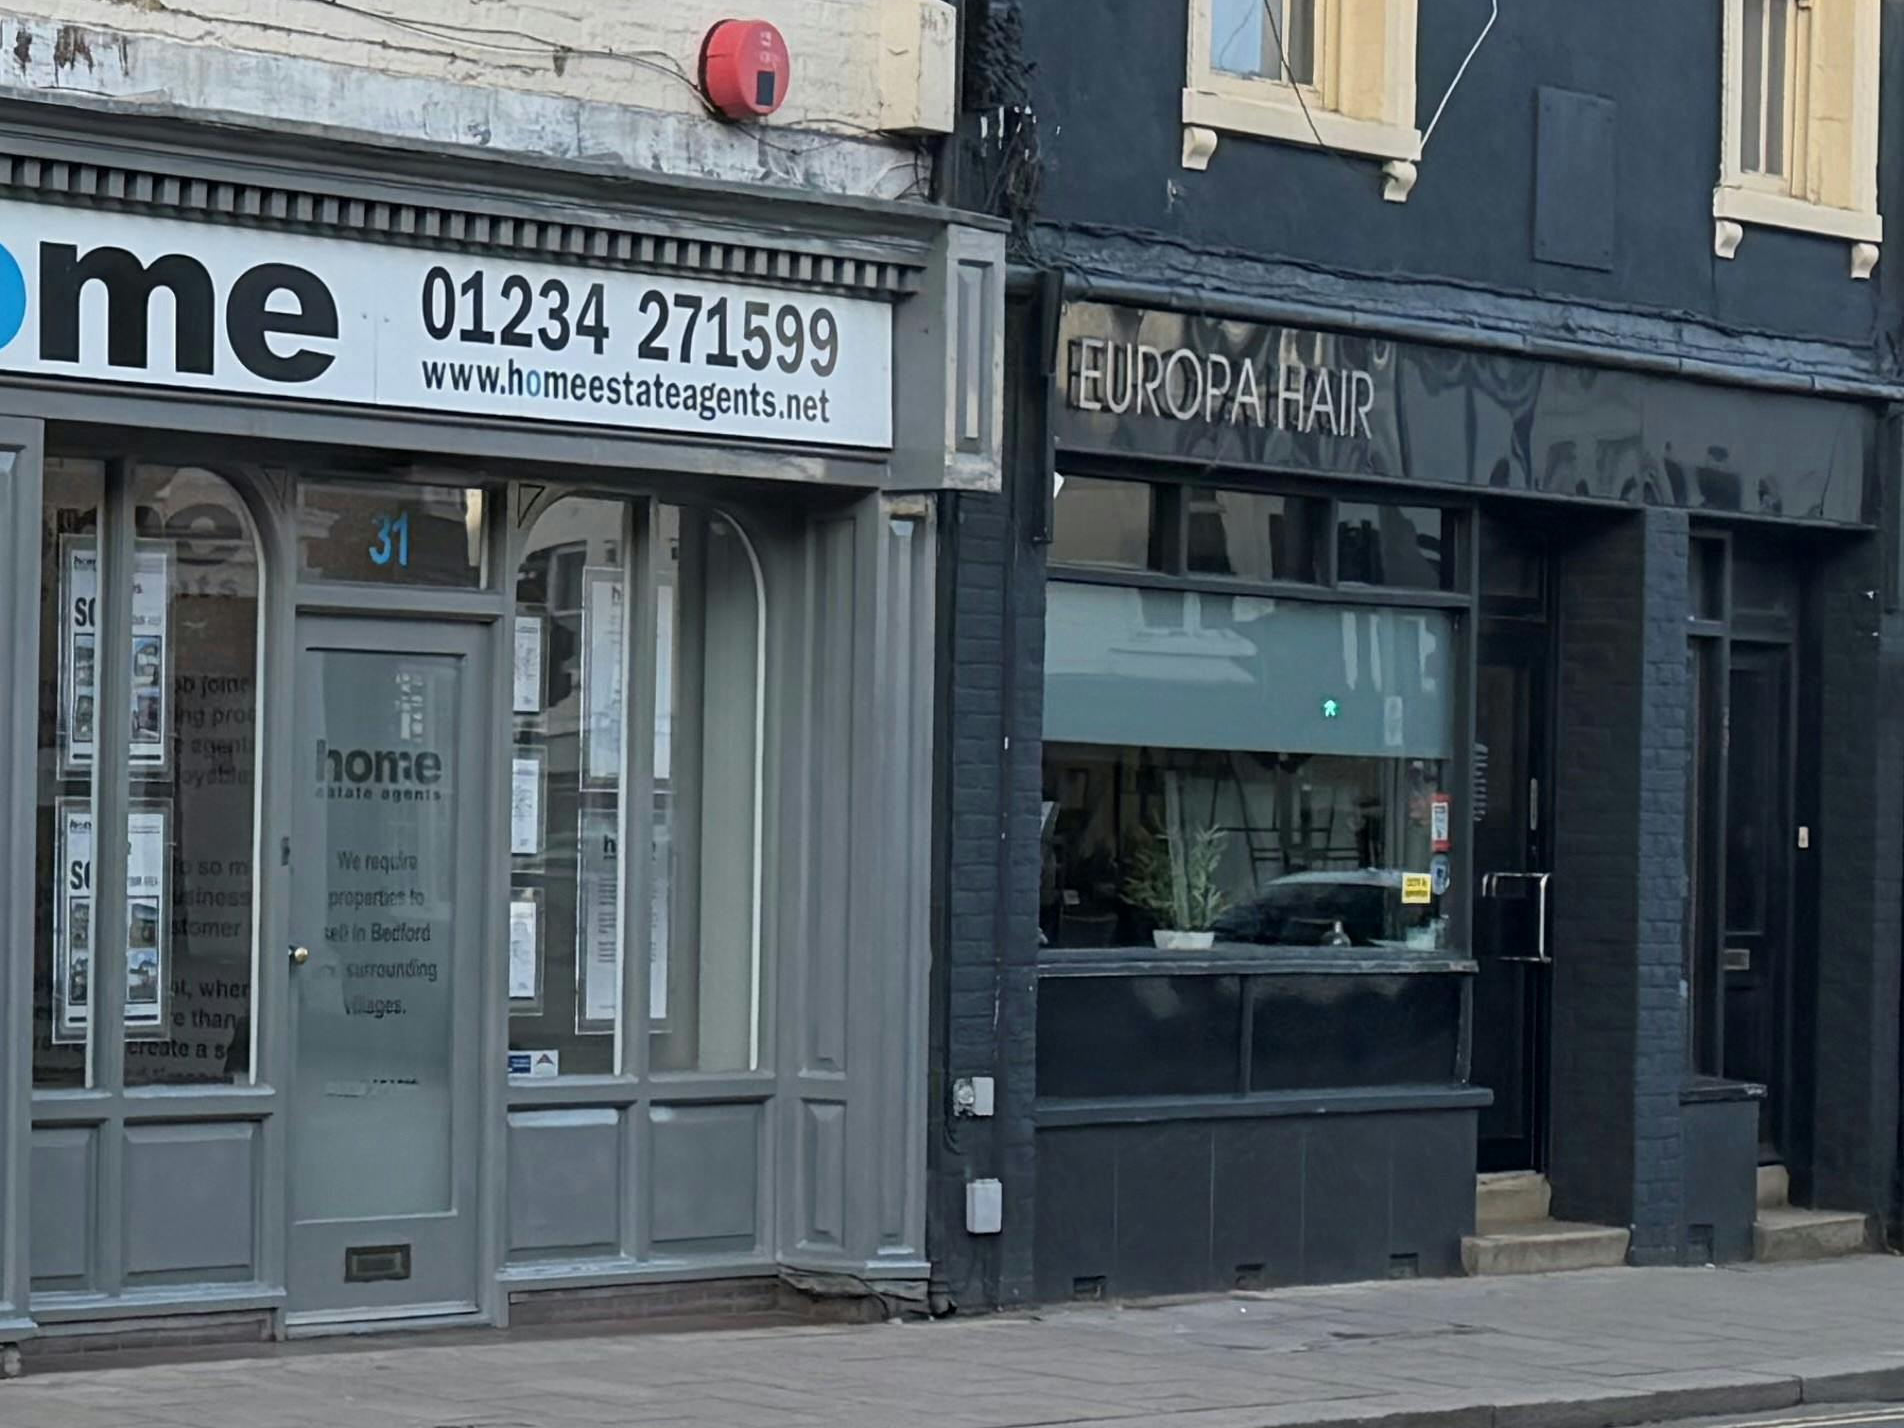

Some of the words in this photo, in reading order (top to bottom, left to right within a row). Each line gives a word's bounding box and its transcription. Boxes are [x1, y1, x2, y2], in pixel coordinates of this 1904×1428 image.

[422, 266, 610, 355] 01234
[637, 289, 839, 377] 271599
[422, 358, 831, 423] www.homeestateagents.net
[1078, 337, 1265, 429] EUROPA
[1277, 362, 1375, 440] HAIR
[368, 510, 411, 567] 31
[315, 738, 442, 784] home
[381, 788, 442, 804] agents
[337, 850, 361, 871] We
[365, 851, 419, 875] require
[328, 889, 406, 911] properties
[410, 887, 426, 907] to
[371, 922, 431, 942] Bedford
[345, 958, 438, 983] surrounding
